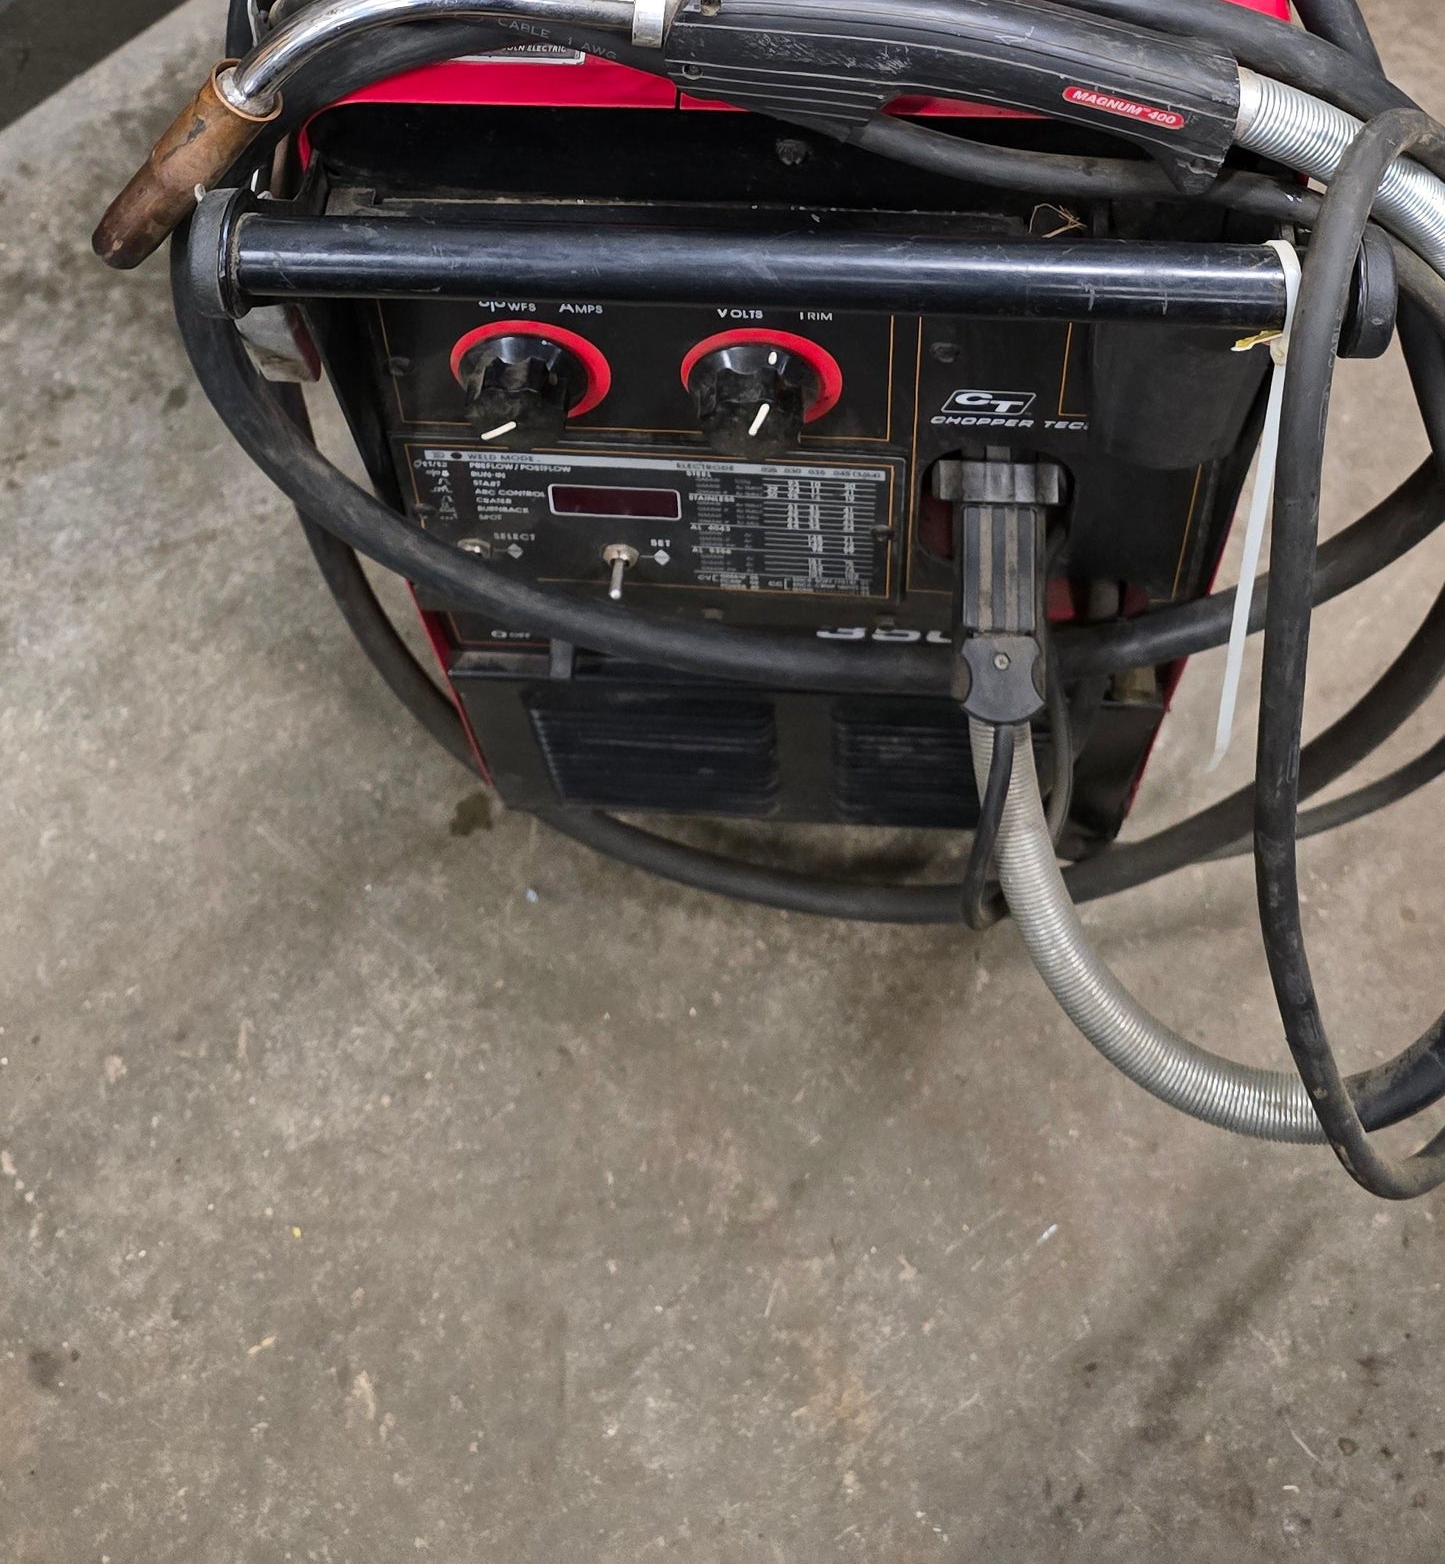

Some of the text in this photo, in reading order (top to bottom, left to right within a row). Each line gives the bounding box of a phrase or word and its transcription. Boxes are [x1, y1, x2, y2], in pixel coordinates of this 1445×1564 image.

[497, 17, 551, 39] CABLE
[581, 42, 617, 60] AWG
[526, 44, 566, 53] ELECTRIC
[1148, 110, 1177, 124] 400
[559, 303, 603, 314] AMPS
[717, 308, 764, 319] VOLTS
[955, 392, 1024, 412] CT
[930, 416, 1034, 428] CHOPPER
[493, 532, 536, 541] SELECT
